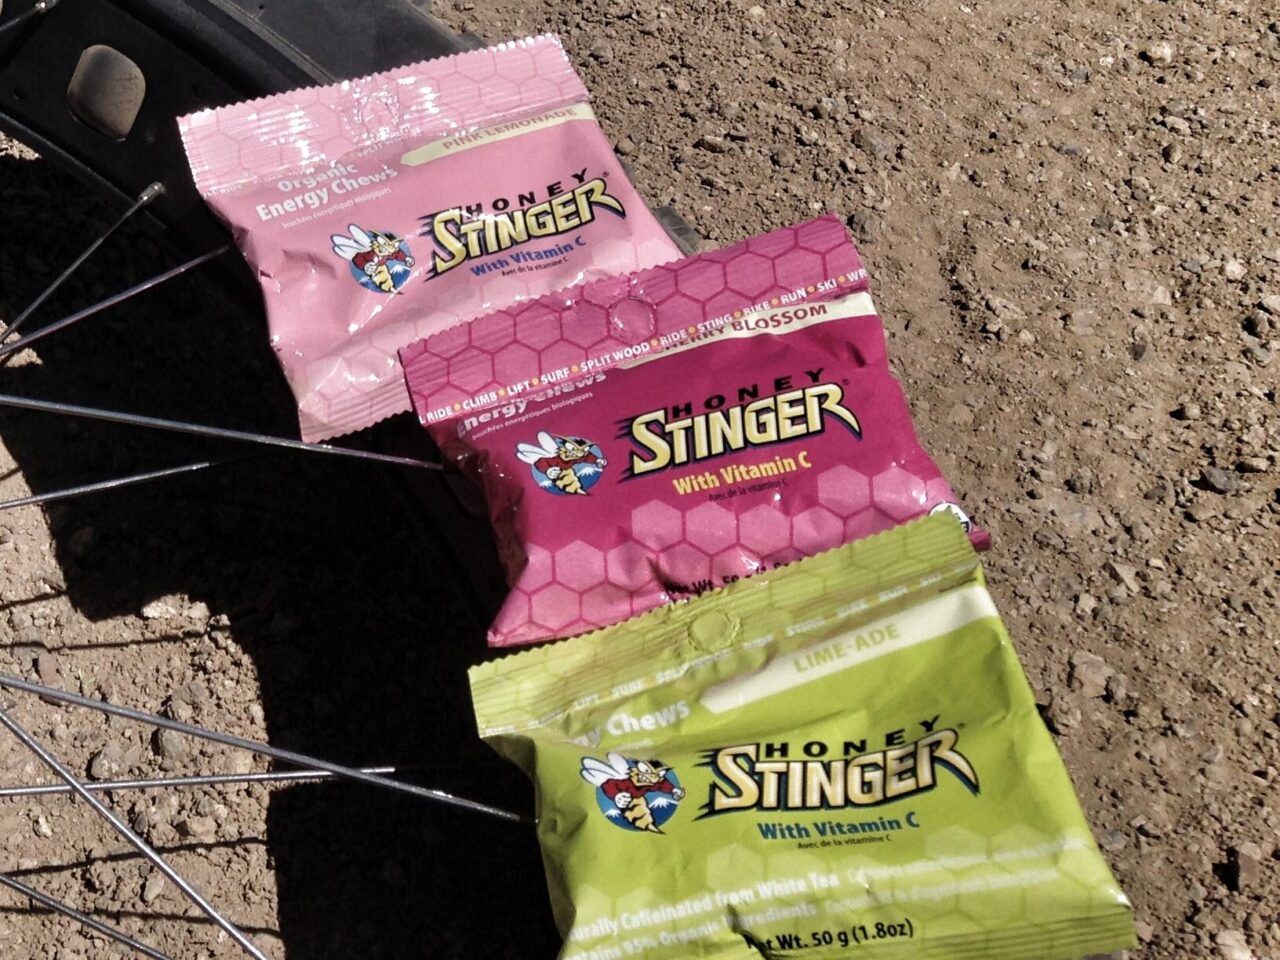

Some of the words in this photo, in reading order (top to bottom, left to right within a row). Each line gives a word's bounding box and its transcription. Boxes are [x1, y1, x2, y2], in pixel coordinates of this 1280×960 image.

[441, 131, 487, 150] PINK
[487, 109, 578, 138] LEMONADE
[255, 187, 330, 221] Energy
[331, 167, 399, 194] Chews
[277, 162, 359, 193] Organic
[466, 167, 588, 218] HONEY
[419, 178, 626, 281] STINGER
[470, 258, 509, 277] With
[509, 243, 574, 264] Vitamin
[575, 236, 587, 247] C
[731, 303, 828, 332] BLOSSOM
[427, 405, 453, 422] RIDE
[463, 391, 498, 410] CLIMB
[507, 380, 532, 396] LIFT
[540, 367, 571, 385] SURF
[580, 354, 613, 372] SPLIT
[613, 341, 650, 361] WOOD
[660, 326, 688, 346] RIDE
[698, 314, 732, 333] STING
[742, 301, 771, 317] BIKE
[781, 287, 807, 304] RUN
[816, 278, 838, 292] SKI
[672, 368, 825, 419] HONEY
[616, 383, 862, 483] STINGER
[673, 472, 719, 495] With
[720, 456, 797, 485] Vitamin
[798, 451, 812, 468] C
[792, 624, 900, 673] LIME-ADE
[607, 701, 690, 735] Chews
[765, 715, 941, 758] HONEY
[693, 728, 980, 821] STINGER
[757, 822, 811, 840] With
[812, 816, 902, 839] Vitamin
[906, 811, 920, 828] C
[797, 841, 818, 850] Avec
[843, 836, 883, 846] vitamine
[757, 877, 807, 901] White
[808, 871, 840, 891] Tea
[775, 934, 808, 951] Wt.
[812, 929, 834, 947] 50
[837, 930, 849, 948] g
[852, 918, 914, 945] (1.8oz)
